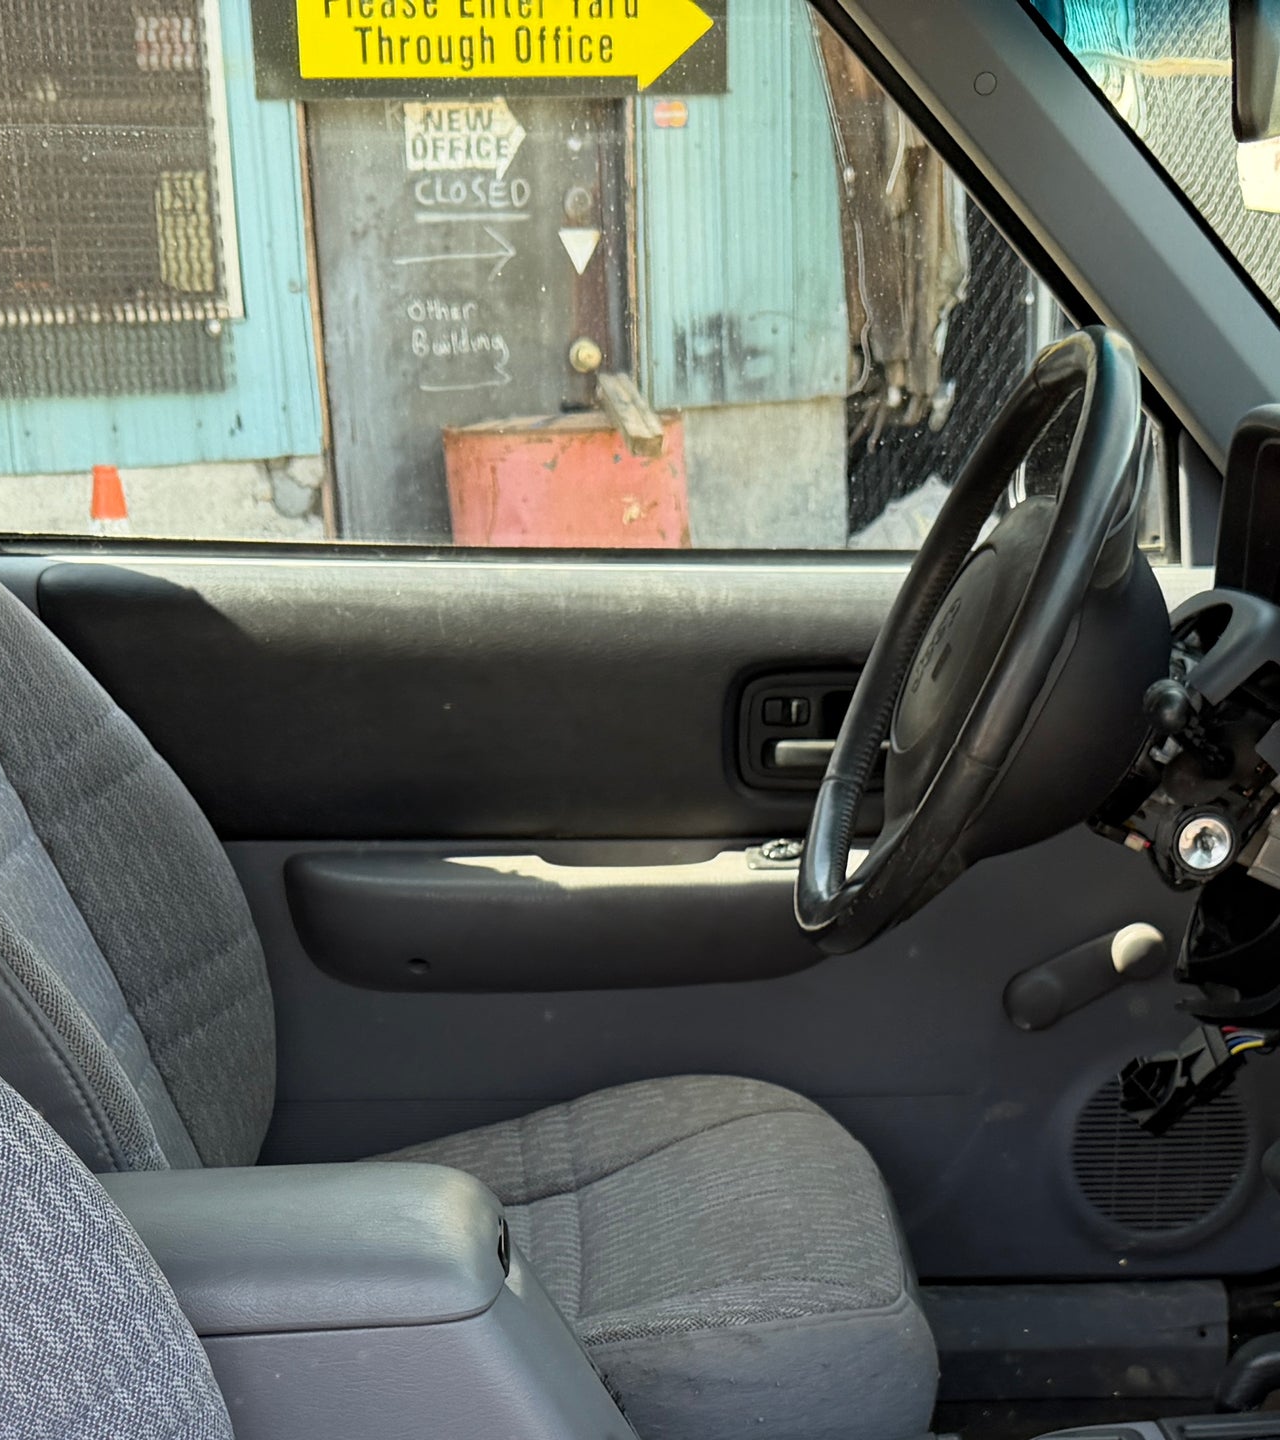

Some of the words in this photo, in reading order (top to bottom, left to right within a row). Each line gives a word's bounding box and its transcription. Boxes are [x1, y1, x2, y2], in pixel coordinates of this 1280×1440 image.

[354, 26, 495, 71] Through
[515, 25, 614, 64] Office
[423, 108, 494, 132] NEW
[411, 133, 511, 162] OFFICE
[415, 176, 531, 208] CLOSED
[407, 296, 478, 321] Other
[411, 326, 510, 363] Building
